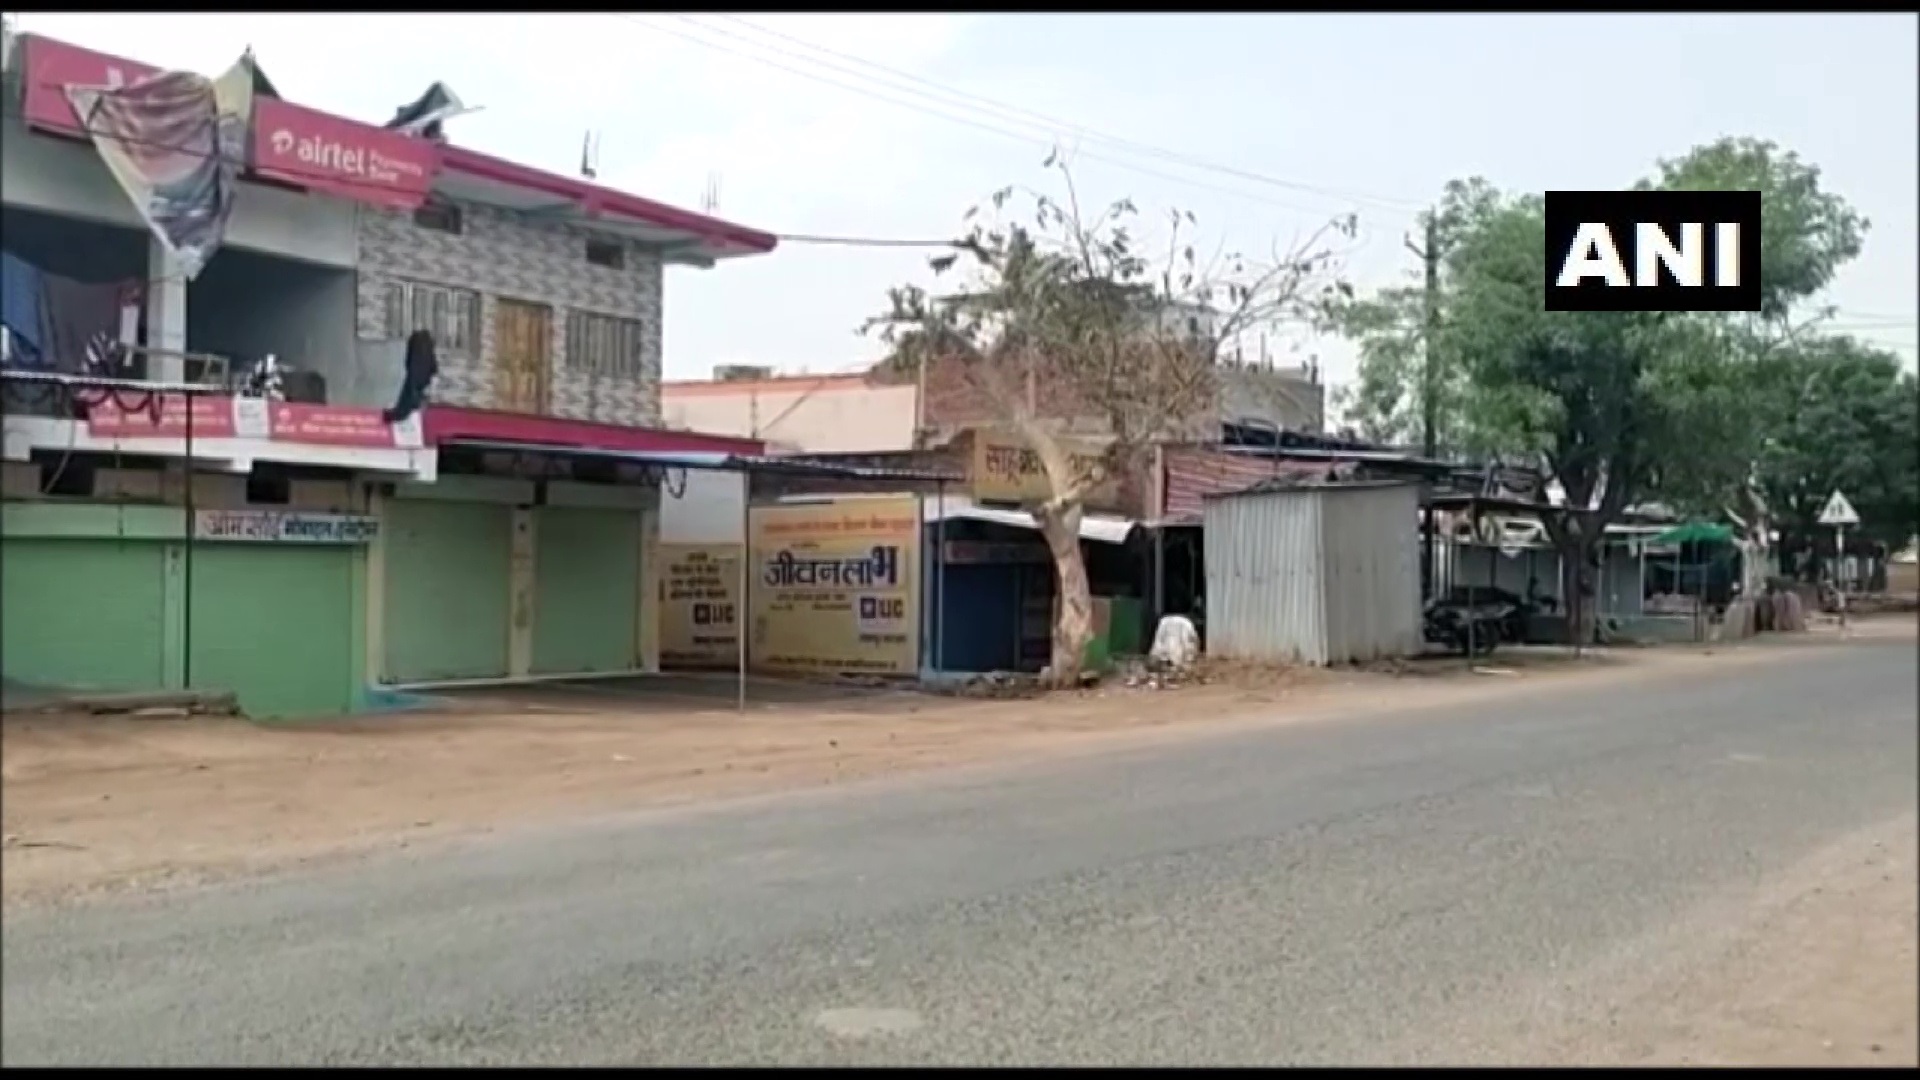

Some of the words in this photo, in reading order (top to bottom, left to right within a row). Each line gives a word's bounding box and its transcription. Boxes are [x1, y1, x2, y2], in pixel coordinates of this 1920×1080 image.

[297, 134, 365, 175] airtel
[764, 550, 841, 586] जीवन
[712, 604, 734, 624] LIC
[879, 598, 904, 619] LIC
